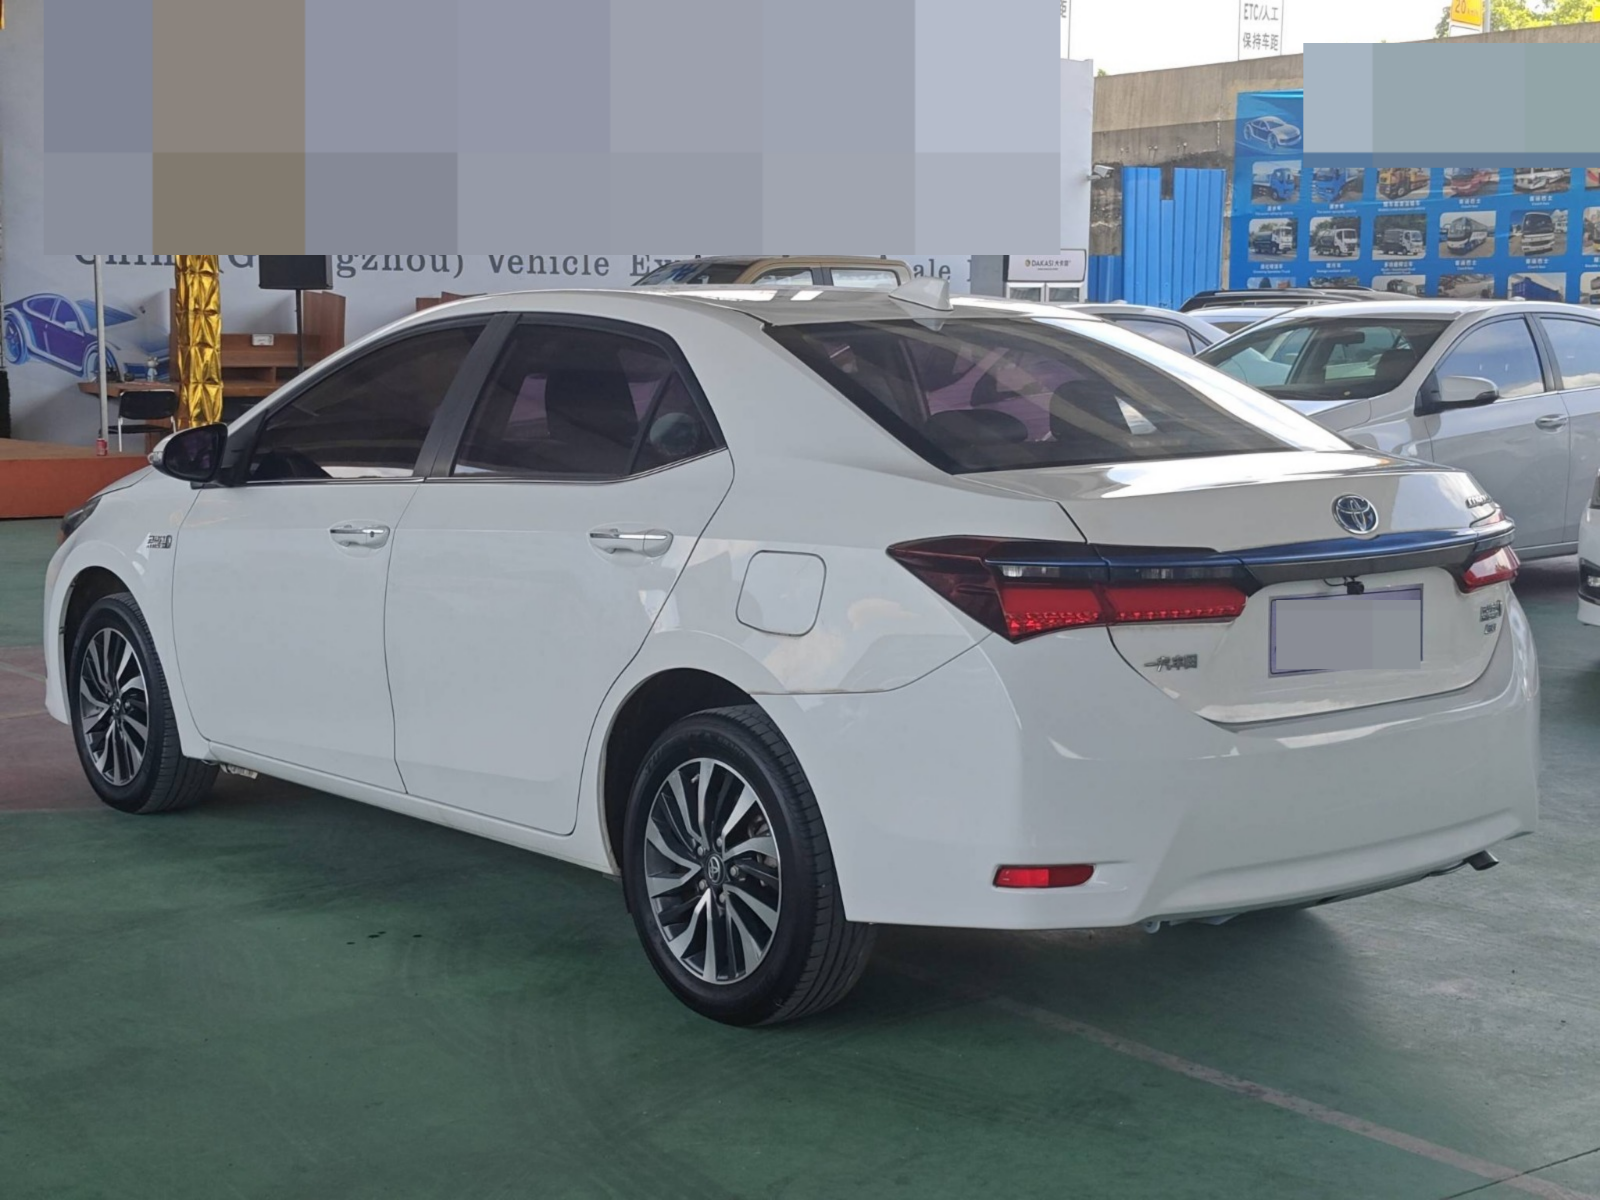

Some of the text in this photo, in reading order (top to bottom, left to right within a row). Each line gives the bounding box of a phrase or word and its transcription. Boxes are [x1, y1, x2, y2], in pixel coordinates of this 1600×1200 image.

[1243, 3, 1279, 21] ETC/人工
[1242, 32, 1279, 51] 保持车距
[488, 255, 609, 277] Vehicle
[913, 258, 951, 281] ale
